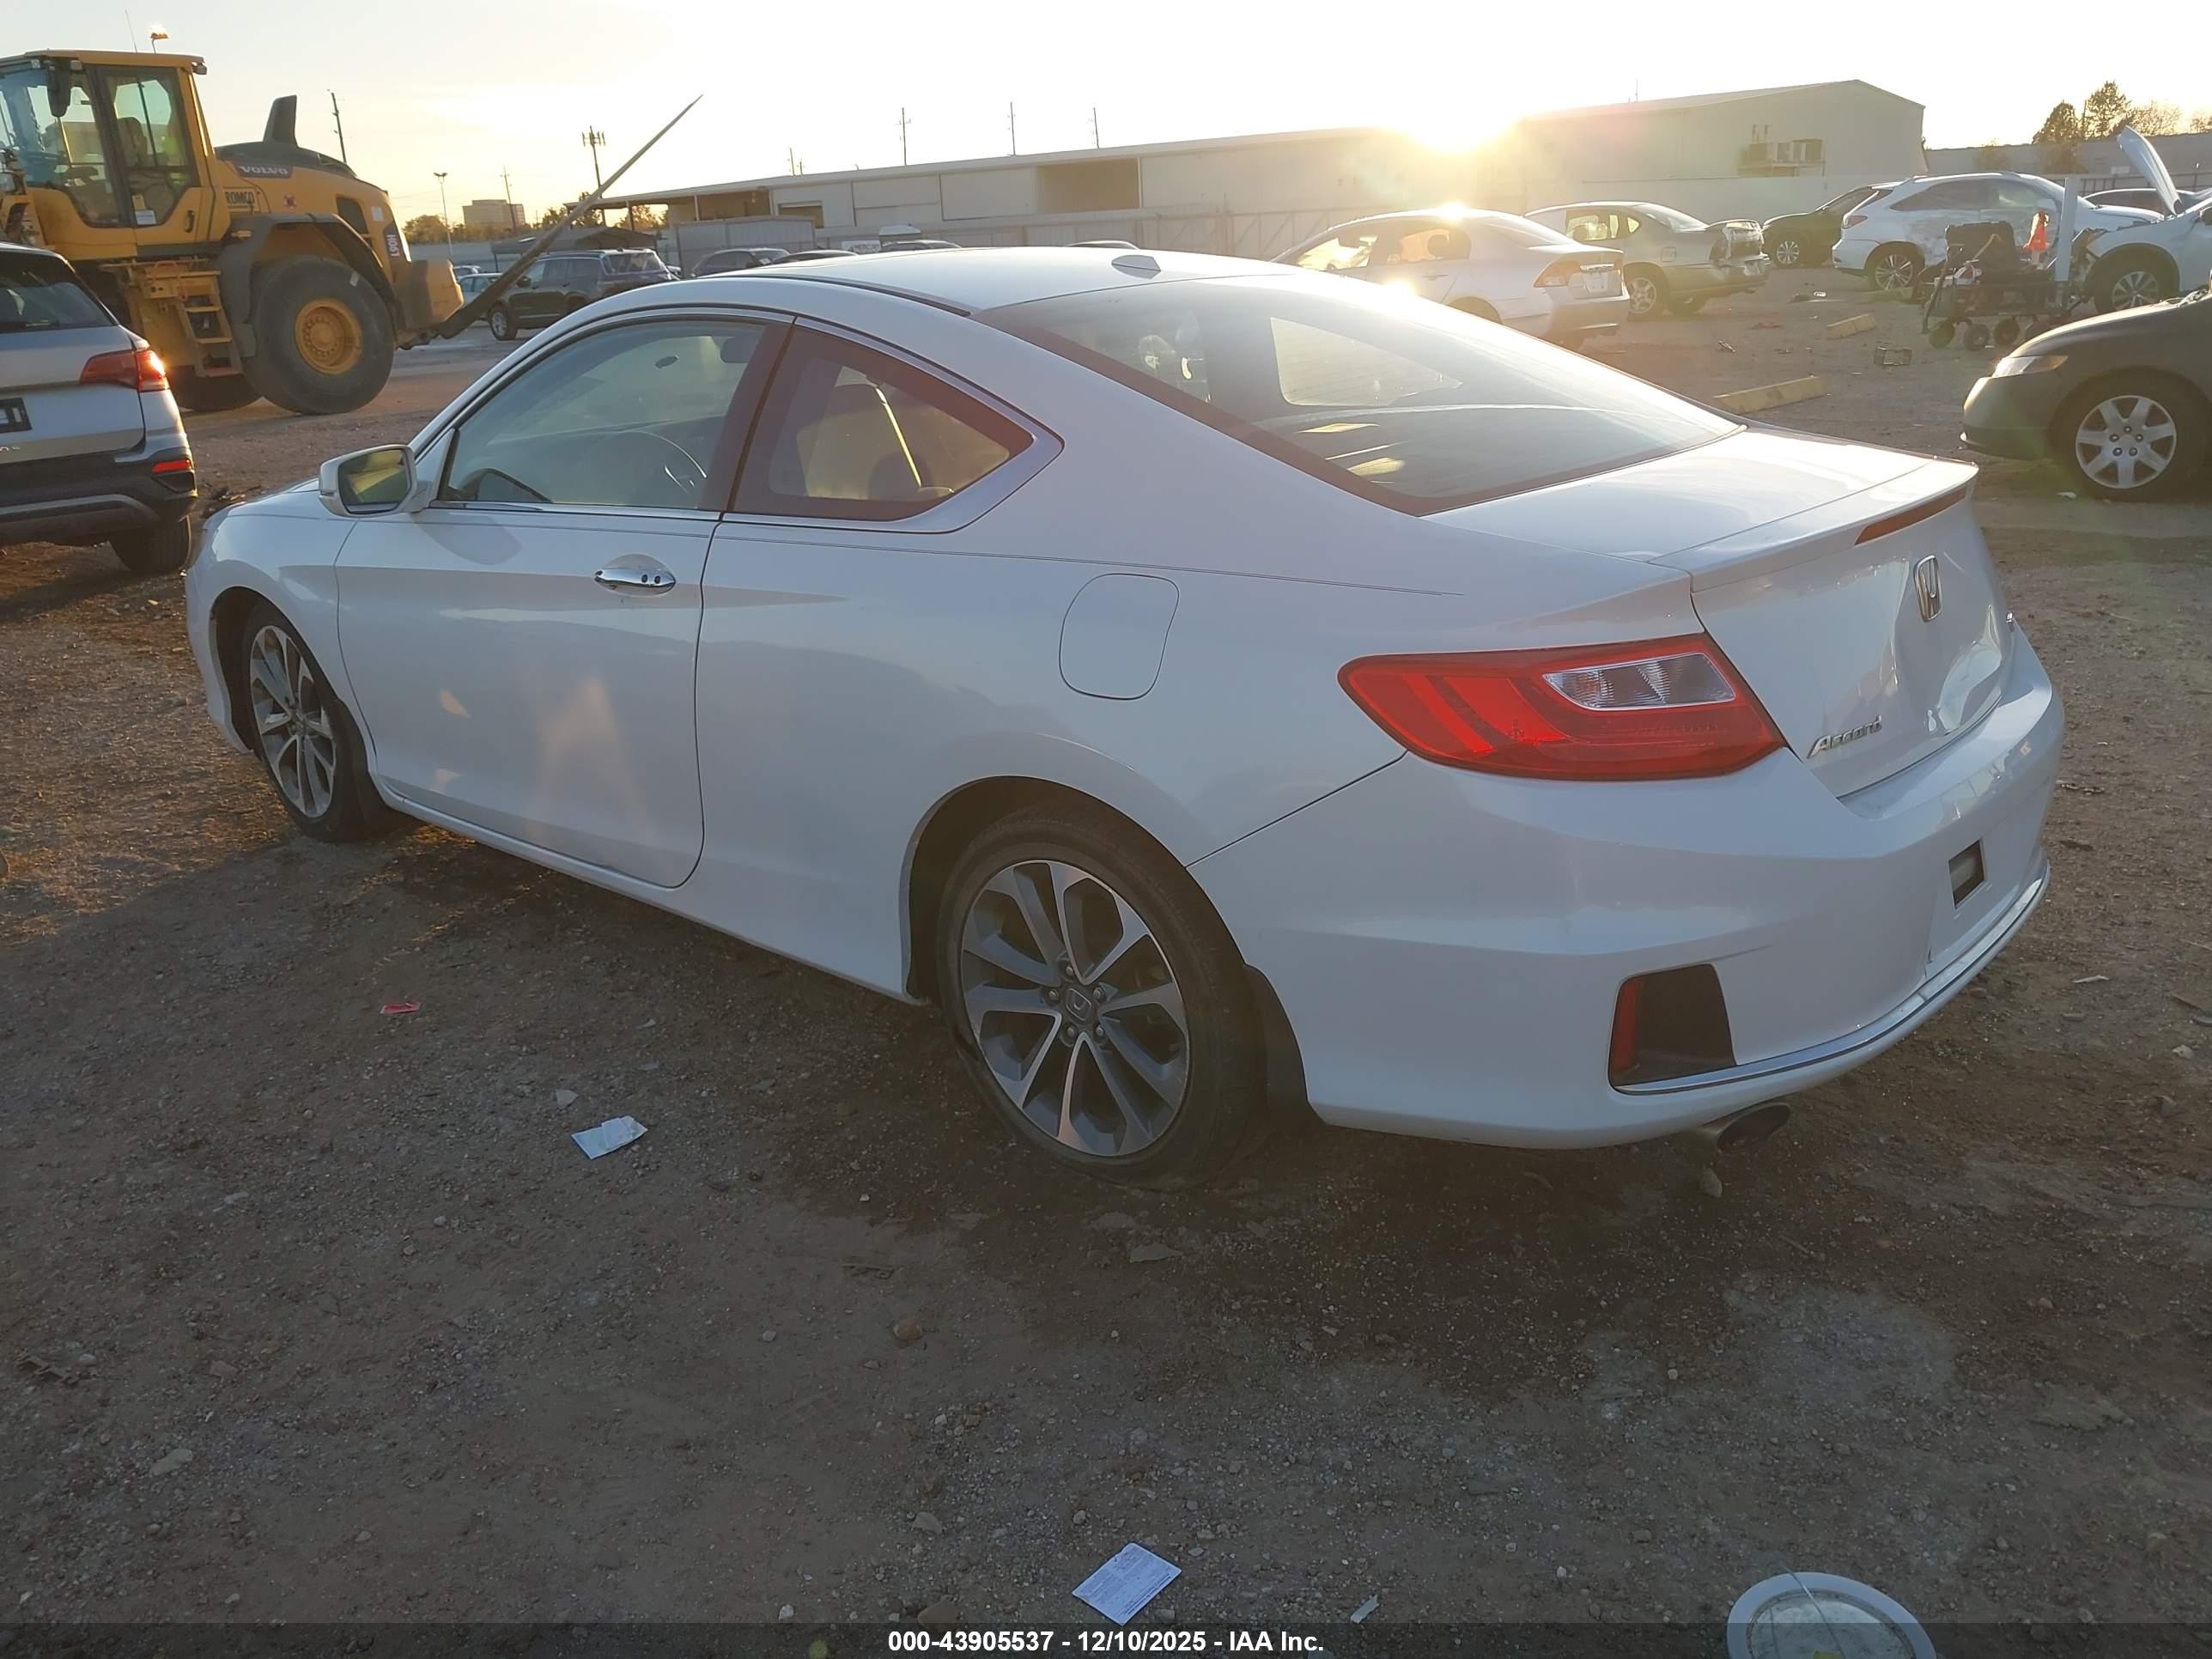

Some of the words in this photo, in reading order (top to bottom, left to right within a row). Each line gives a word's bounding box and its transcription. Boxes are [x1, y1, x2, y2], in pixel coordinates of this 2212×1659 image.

[239, 166, 289, 175] VOLVO
[225, 191, 254, 204] ROMCO
[386, 234, 400, 257] L90H
[1806, 714, 1882, 759] Accord
